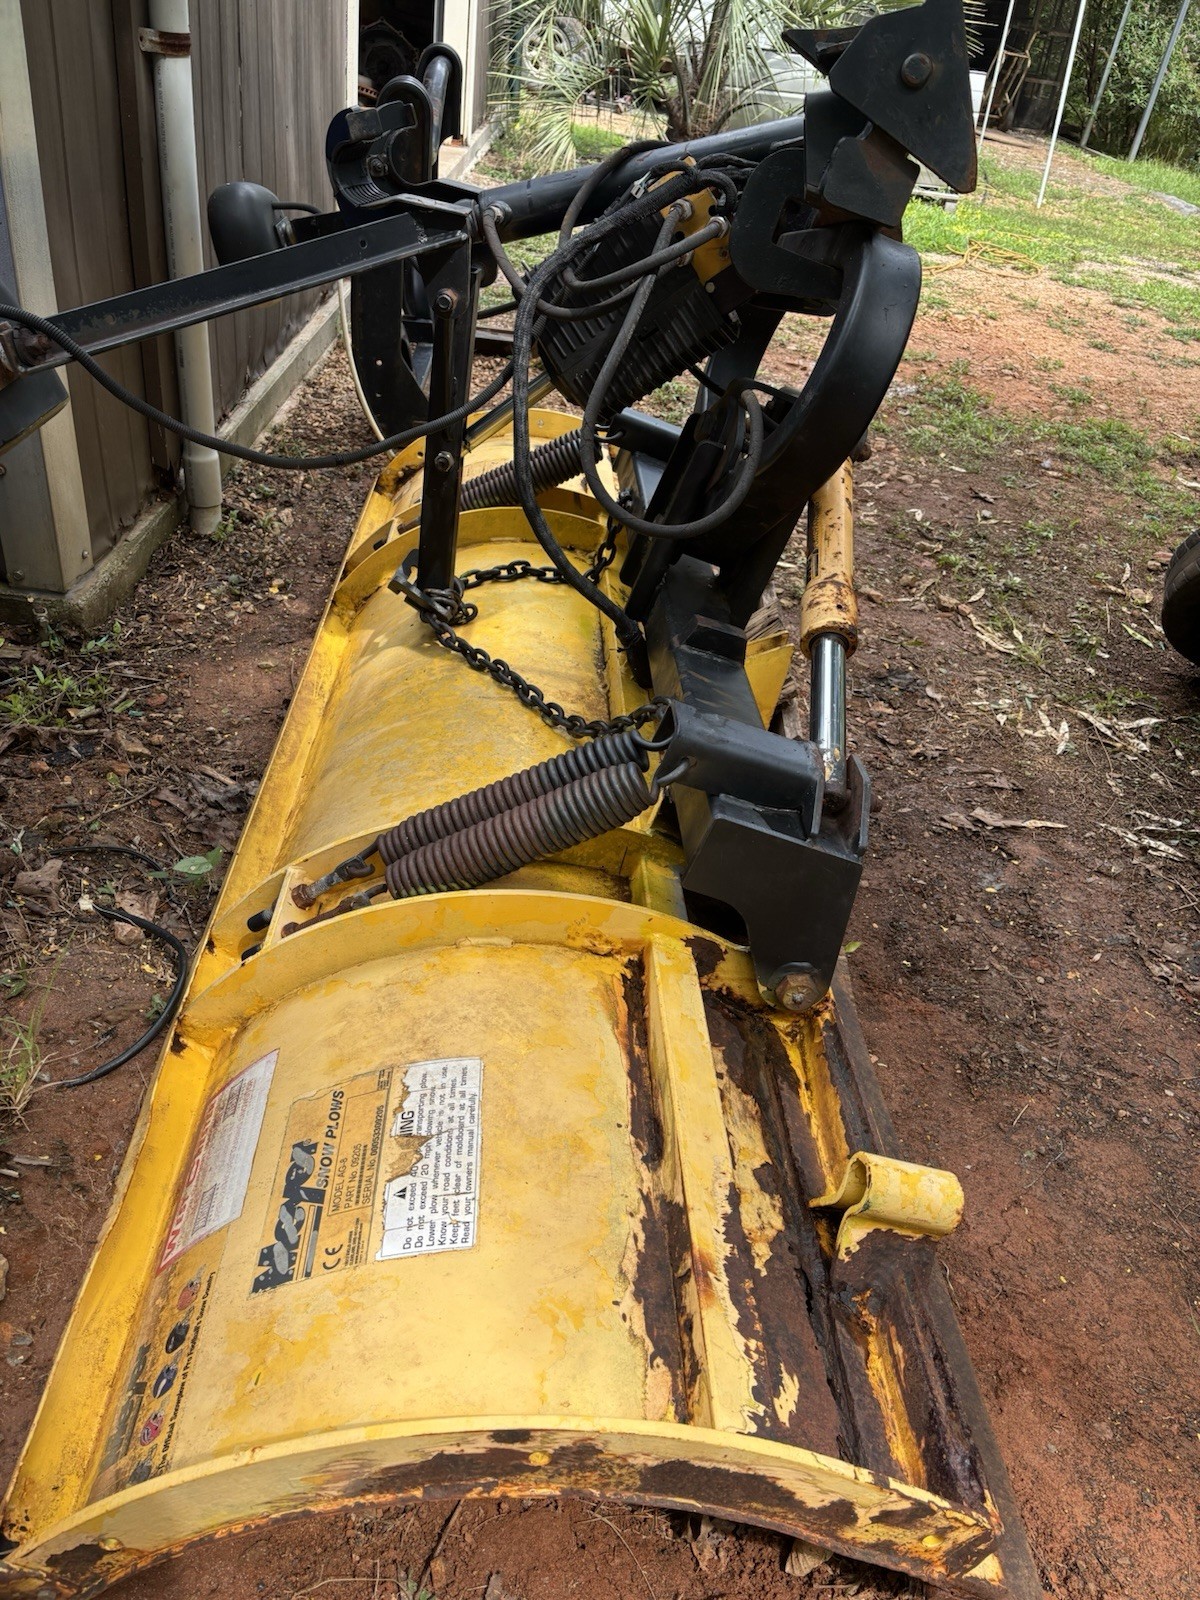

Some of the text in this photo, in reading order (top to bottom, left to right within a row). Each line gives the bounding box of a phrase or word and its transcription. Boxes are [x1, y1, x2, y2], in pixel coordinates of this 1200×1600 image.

[417, 1093, 427, 1135] ransporting
[448, 1115, 454, 1123] at
[316, 1090, 344, 1188] SNOW PLOWS
[456, 1116, 464, 1155] moldboard
[351, 1144, 362, 1167] 09205
[424, 1142, 432, 1159] mph
[445, 1128, 453, 1167] conditions
[350, 1168, 358, 1180] No.
[367, 1158, 376, 1171] No.
[410, 1166, 418, 1177] 40
[421, 1164, 429, 1176] 20
[431, 1152, 440, 1189] whenever
[332, 1158, 348, 1212] MODEL AG-8
[453, 1174, 461, 1194] clear
[465, 1162, 473, 1191] owners
[344, 1184, 356, 1209] PART
[362, 1174, 373, 1205] SERIAL
[408, 1182, 416, 1211] exceed
[429, 1194, 438, 1214] plow
[451, 1200, 459, 1216] feet
[406, 1216, 414, 1231] not
[426, 1220, 436, 1247] Lower
[438, 1221, 447, 1246] Know
[450, 1222, 461, 1244] Keep
[461, 1221, 470, 1244] Read
[402, 1237, 412, 1250] Do
[414, 1236, 423, 1248] Do
[162, 1422, 175, 1452] Official
[170, 1381, 186, 1422] Snowplow
[183, 1357, 192, 1371] Pro
[196, 1300, 206, 1320] Snow
[202, 1271, 216, 1299] Country
